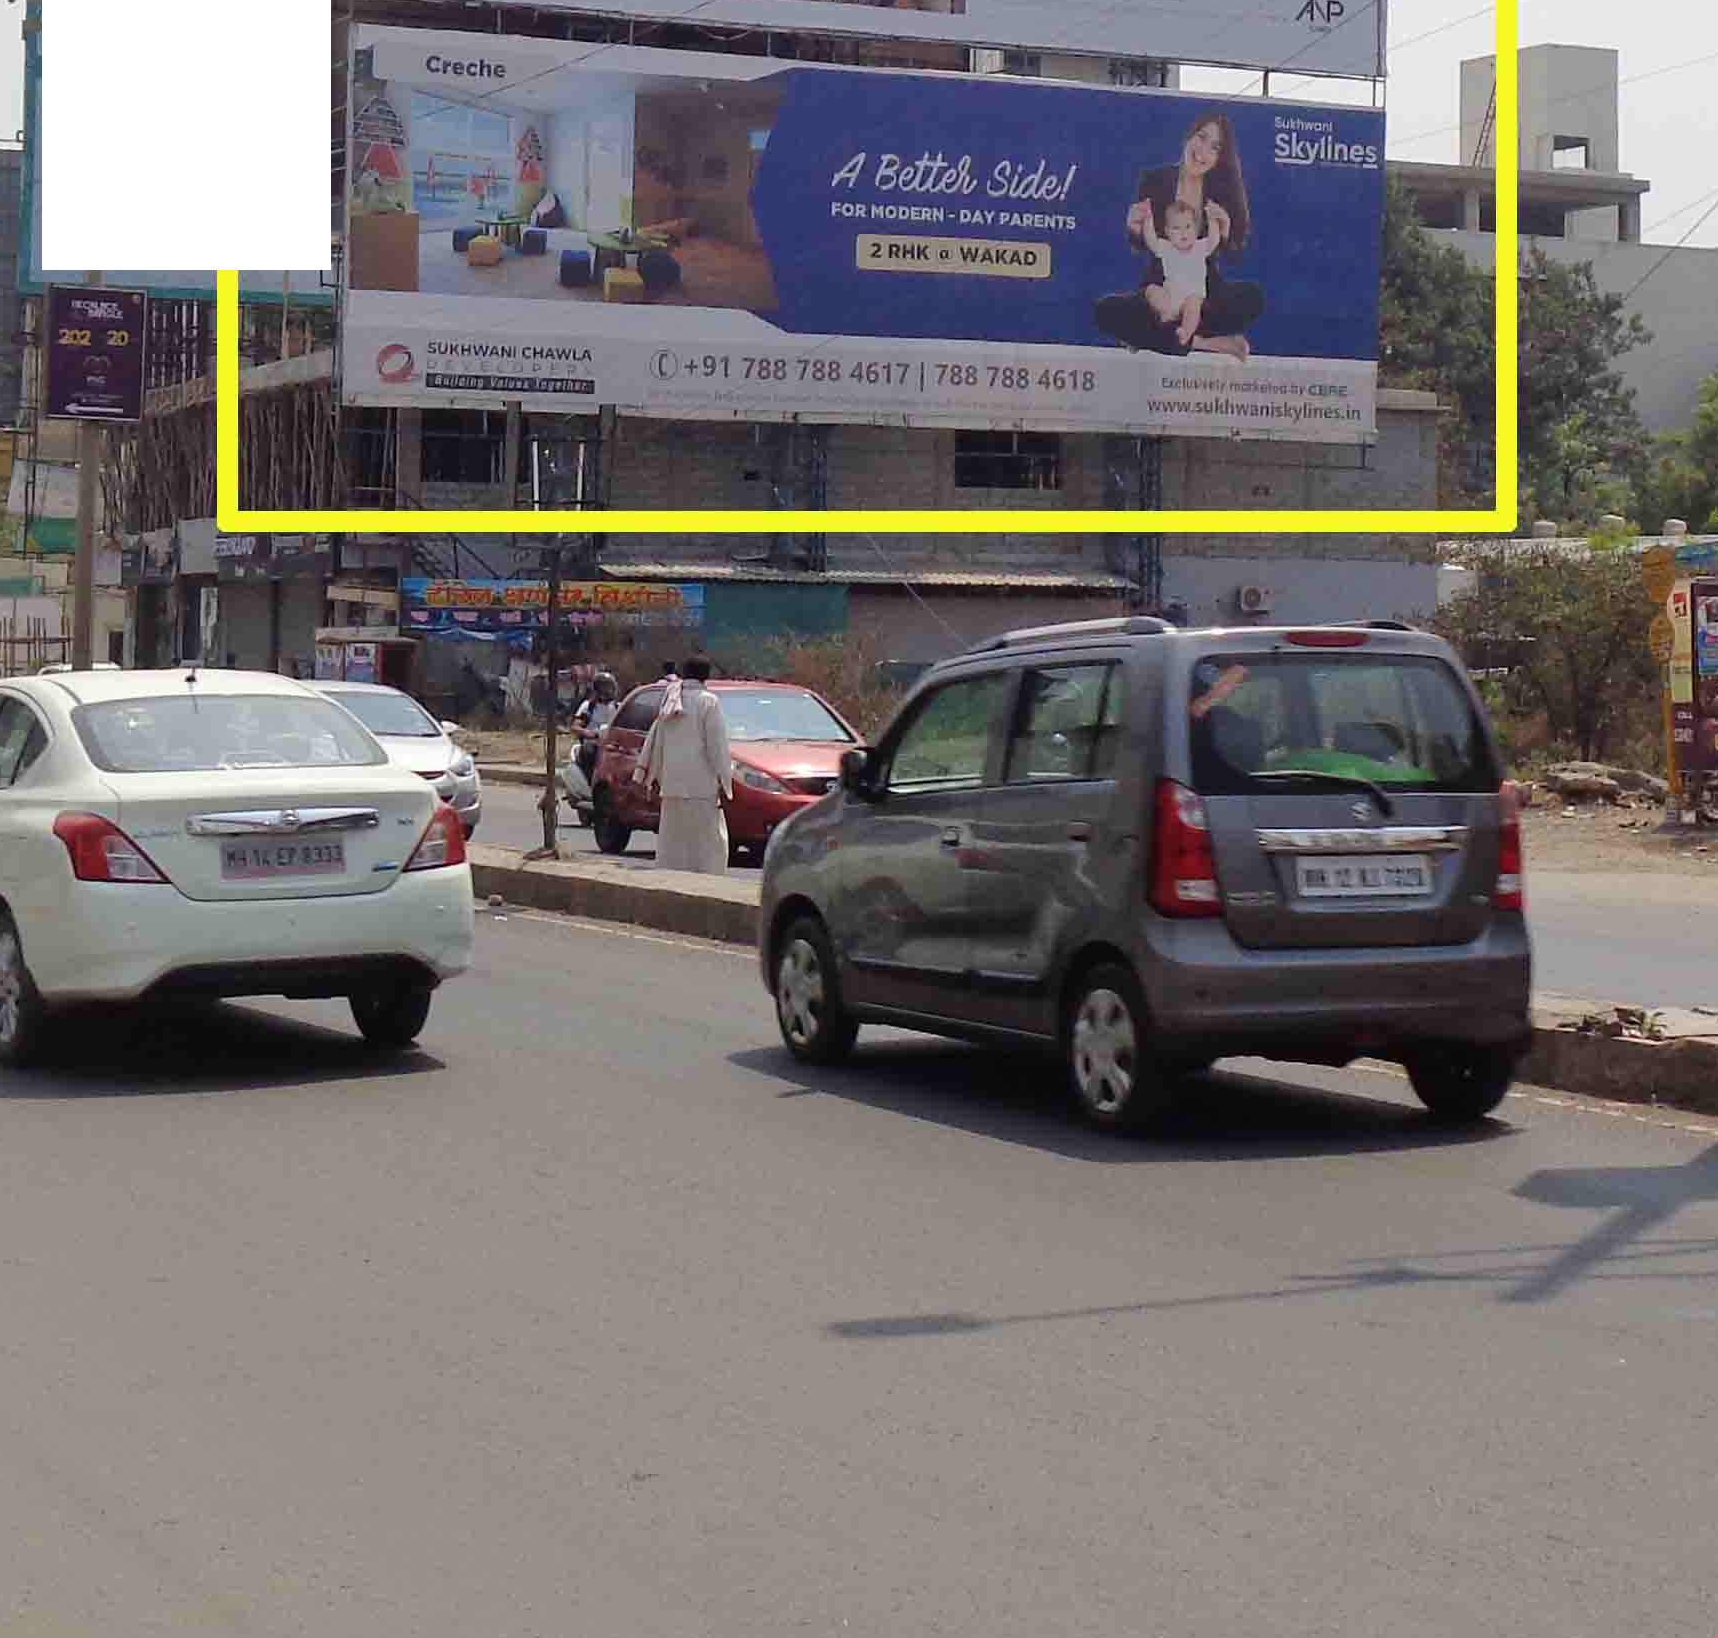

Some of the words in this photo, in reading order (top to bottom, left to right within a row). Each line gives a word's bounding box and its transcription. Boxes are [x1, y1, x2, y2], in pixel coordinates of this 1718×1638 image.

[426, 54, 507, 79] Creche
[1275, 116, 1333, 132] Sukhwani
[1275, 132, 1379, 166] Skylines
[831, 152, 866, 188] A
[875, 151, 978, 196] Better
[986, 159, 1079, 202] Side!
[831, 201, 867, 219] FOR
[871, 204, 945, 223] MODERN
[960, 209, 995, 225] DAY
[999, 212, 1076, 231] PARENTS
[870, 242, 882, 259] 2
[960, 246, 1038, 267] WAKAD
[427, 341, 517, 359] SUKHWANI
[522, 346, 593, 363] CHAWLA
[683, 355, 731, 378] +91
[742, 357, 787, 380] 788
[796, 359, 841, 382] 788
[850, 361, 911, 387] 4617
[934, 363, 979, 387] 788
[987, 365, 1031, 390] 788
[1036, 368, 1097, 392] 4618
[1161, 377, 1227, 393] Exclusively
[1148, 398, 1362, 424] www.sukhwaniskylines.in
